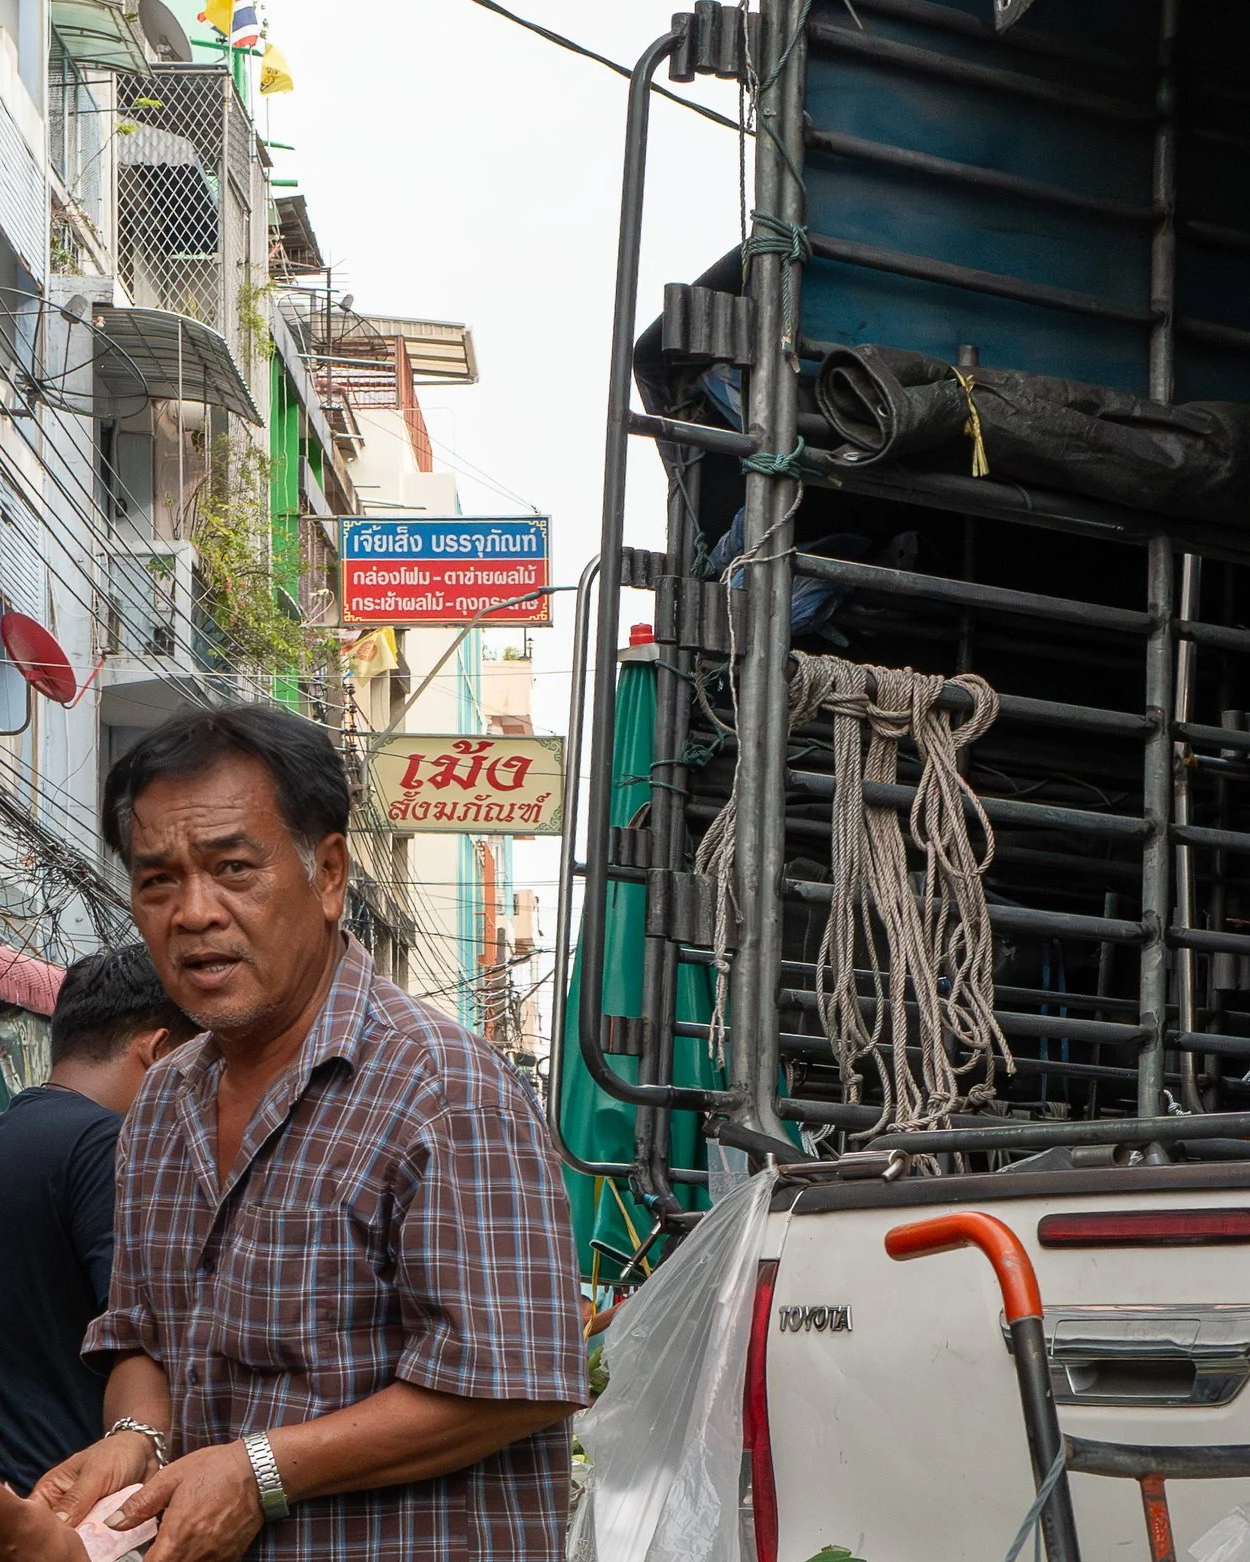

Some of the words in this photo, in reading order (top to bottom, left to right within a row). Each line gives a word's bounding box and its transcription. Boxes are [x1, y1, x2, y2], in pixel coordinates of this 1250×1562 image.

[353, 524, 423, 553] เจี้ยเส็ง
[431, 527, 538, 558] บรรจุภัณฑ์
[353, 566, 431, 585] กล่องโฟม
[444, 565, 536, 585] ตาข่ายผลไม้
[351, 591, 444, 611] กระเช้าผลไม้
[399, 739, 534, 792] เม้ง
[388, 791, 552, 824] สังฆภัณฑ์
[778, 1304, 853, 1332] TOYOTA
